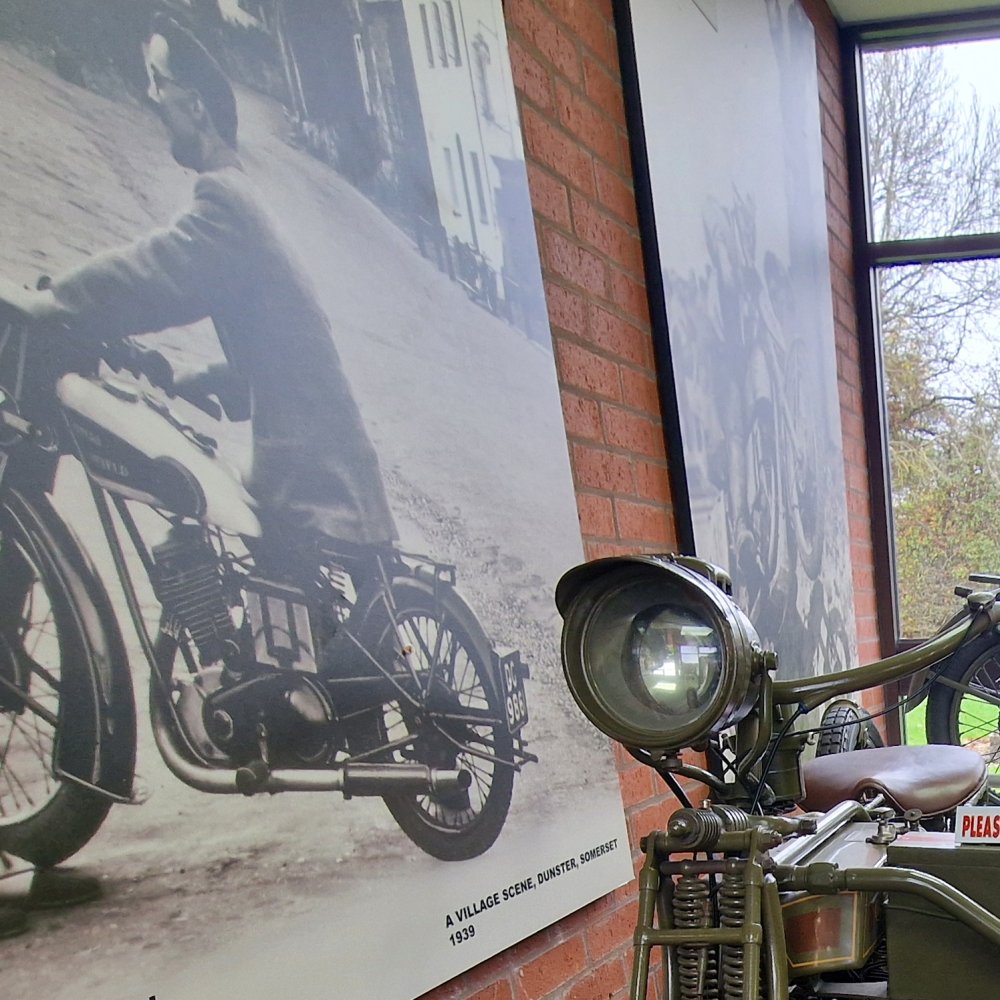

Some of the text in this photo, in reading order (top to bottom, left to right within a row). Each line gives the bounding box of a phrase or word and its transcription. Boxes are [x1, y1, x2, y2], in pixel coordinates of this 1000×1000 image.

[445, 838, 618, 928] A VILLAGE SCENE, DUNSTER, SOMERSET
[449, 924, 476, 947] 1939
